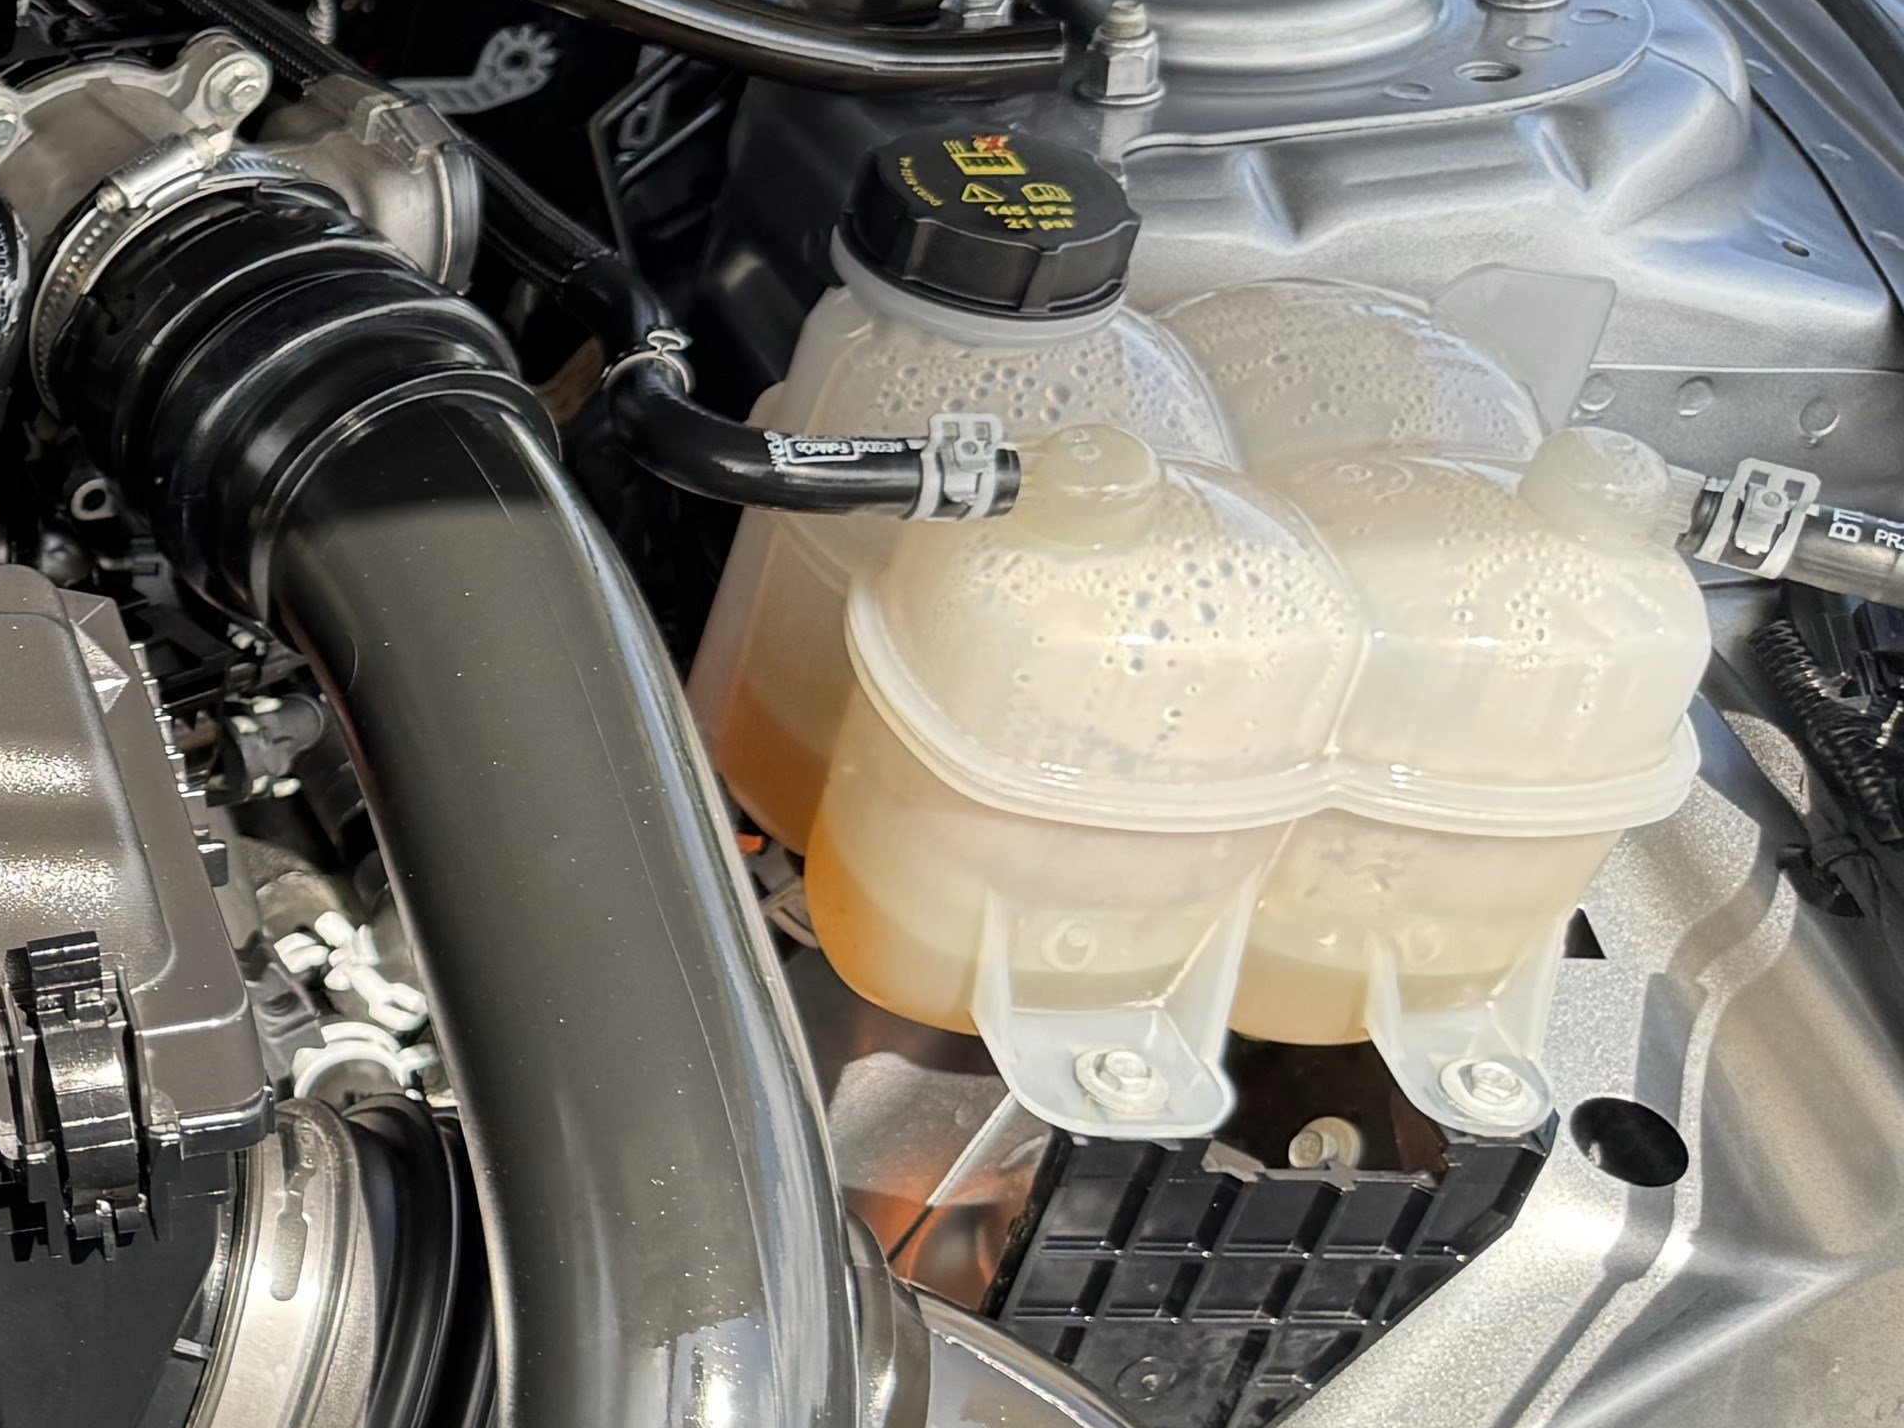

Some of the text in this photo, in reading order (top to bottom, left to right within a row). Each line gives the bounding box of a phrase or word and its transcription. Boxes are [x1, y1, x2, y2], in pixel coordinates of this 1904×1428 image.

[984, 204, 1074, 216] 145 kPa
[1004, 218, 1073, 230] 21 psi
[795, 442, 851, 455] FoMoCo
